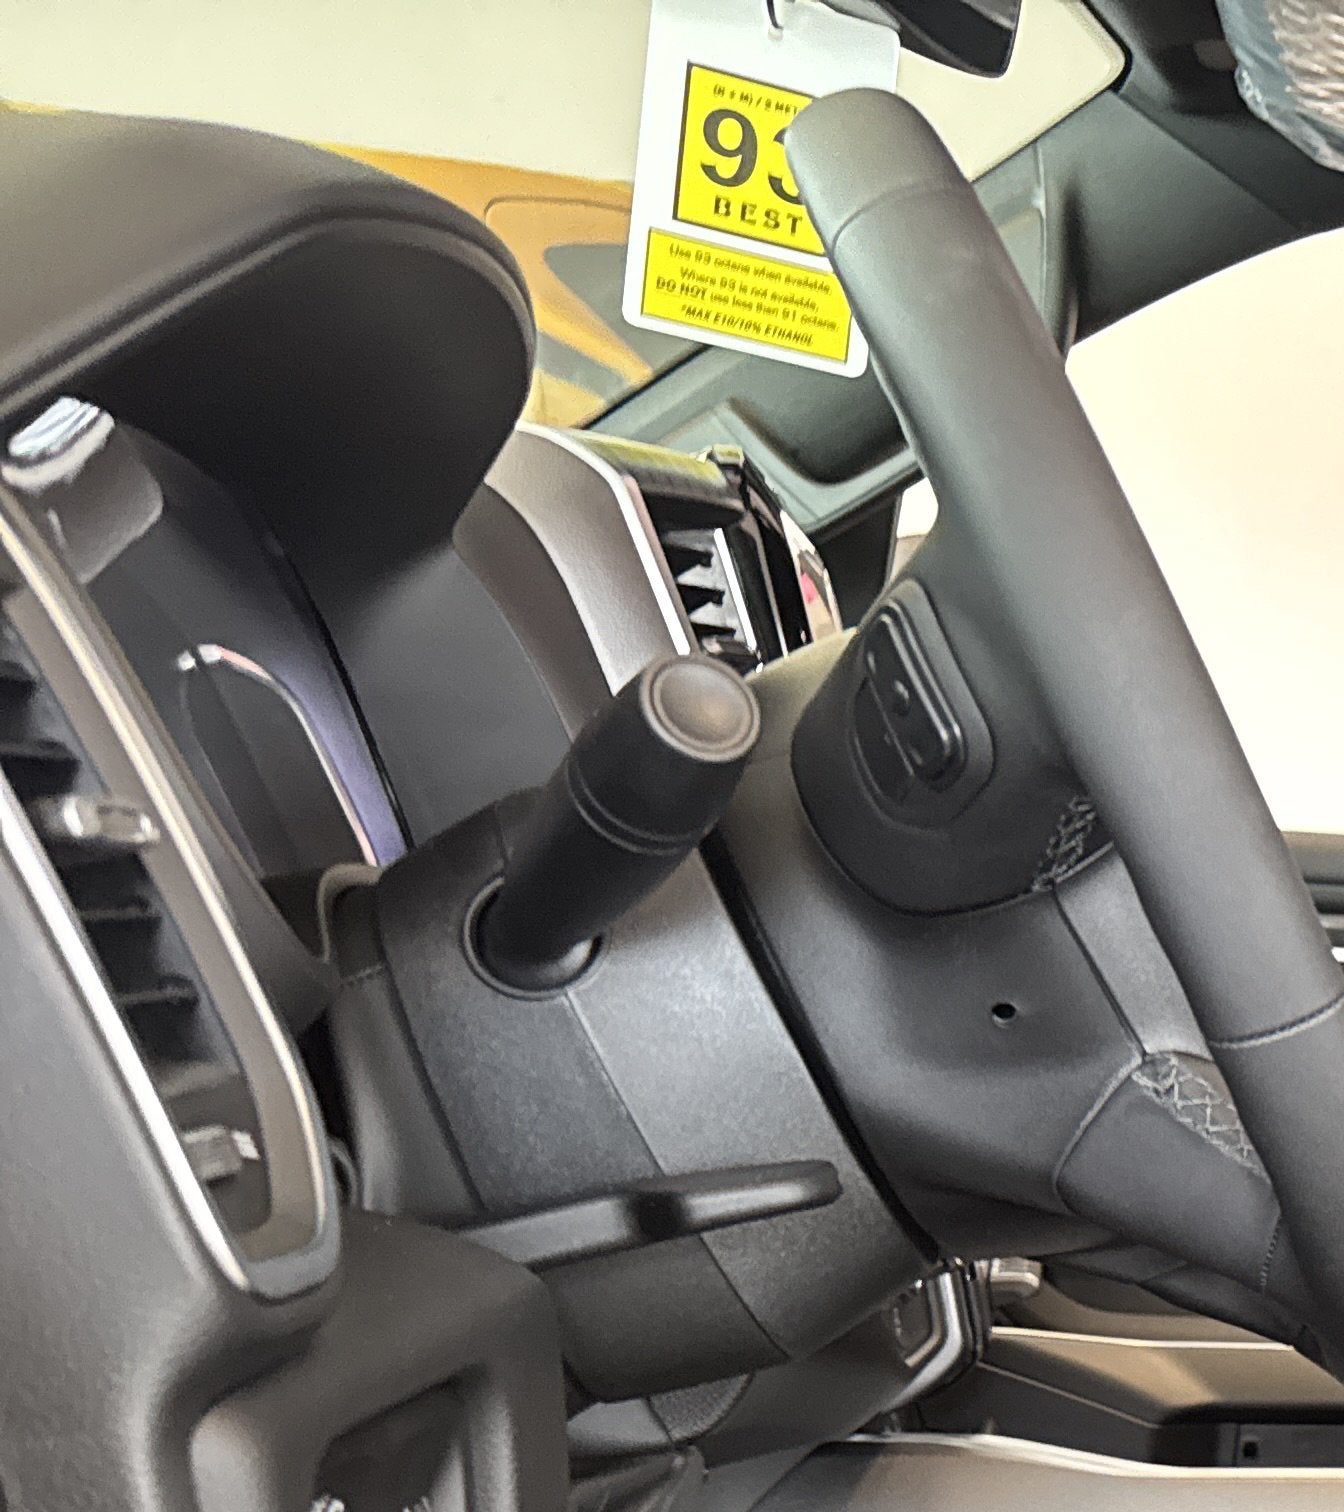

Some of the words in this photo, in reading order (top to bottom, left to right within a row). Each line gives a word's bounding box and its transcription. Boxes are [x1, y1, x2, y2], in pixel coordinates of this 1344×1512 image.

[713, 195, 803, 236] BEST
[669, 243, 691, 260] Use
[753, 267, 782, 282] when
[656, 276, 676, 293] DO
[680, 282, 707, 300] NOT
[710, 293, 729, 305] use
[732, 295, 753, 311] less
[756, 302, 779, 317] than
[680, 266, 716, 286] Where
[738, 282, 748, 295] is
[750, 287, 768, 299] not
[764, 324, 812, 346] ETHANOL
